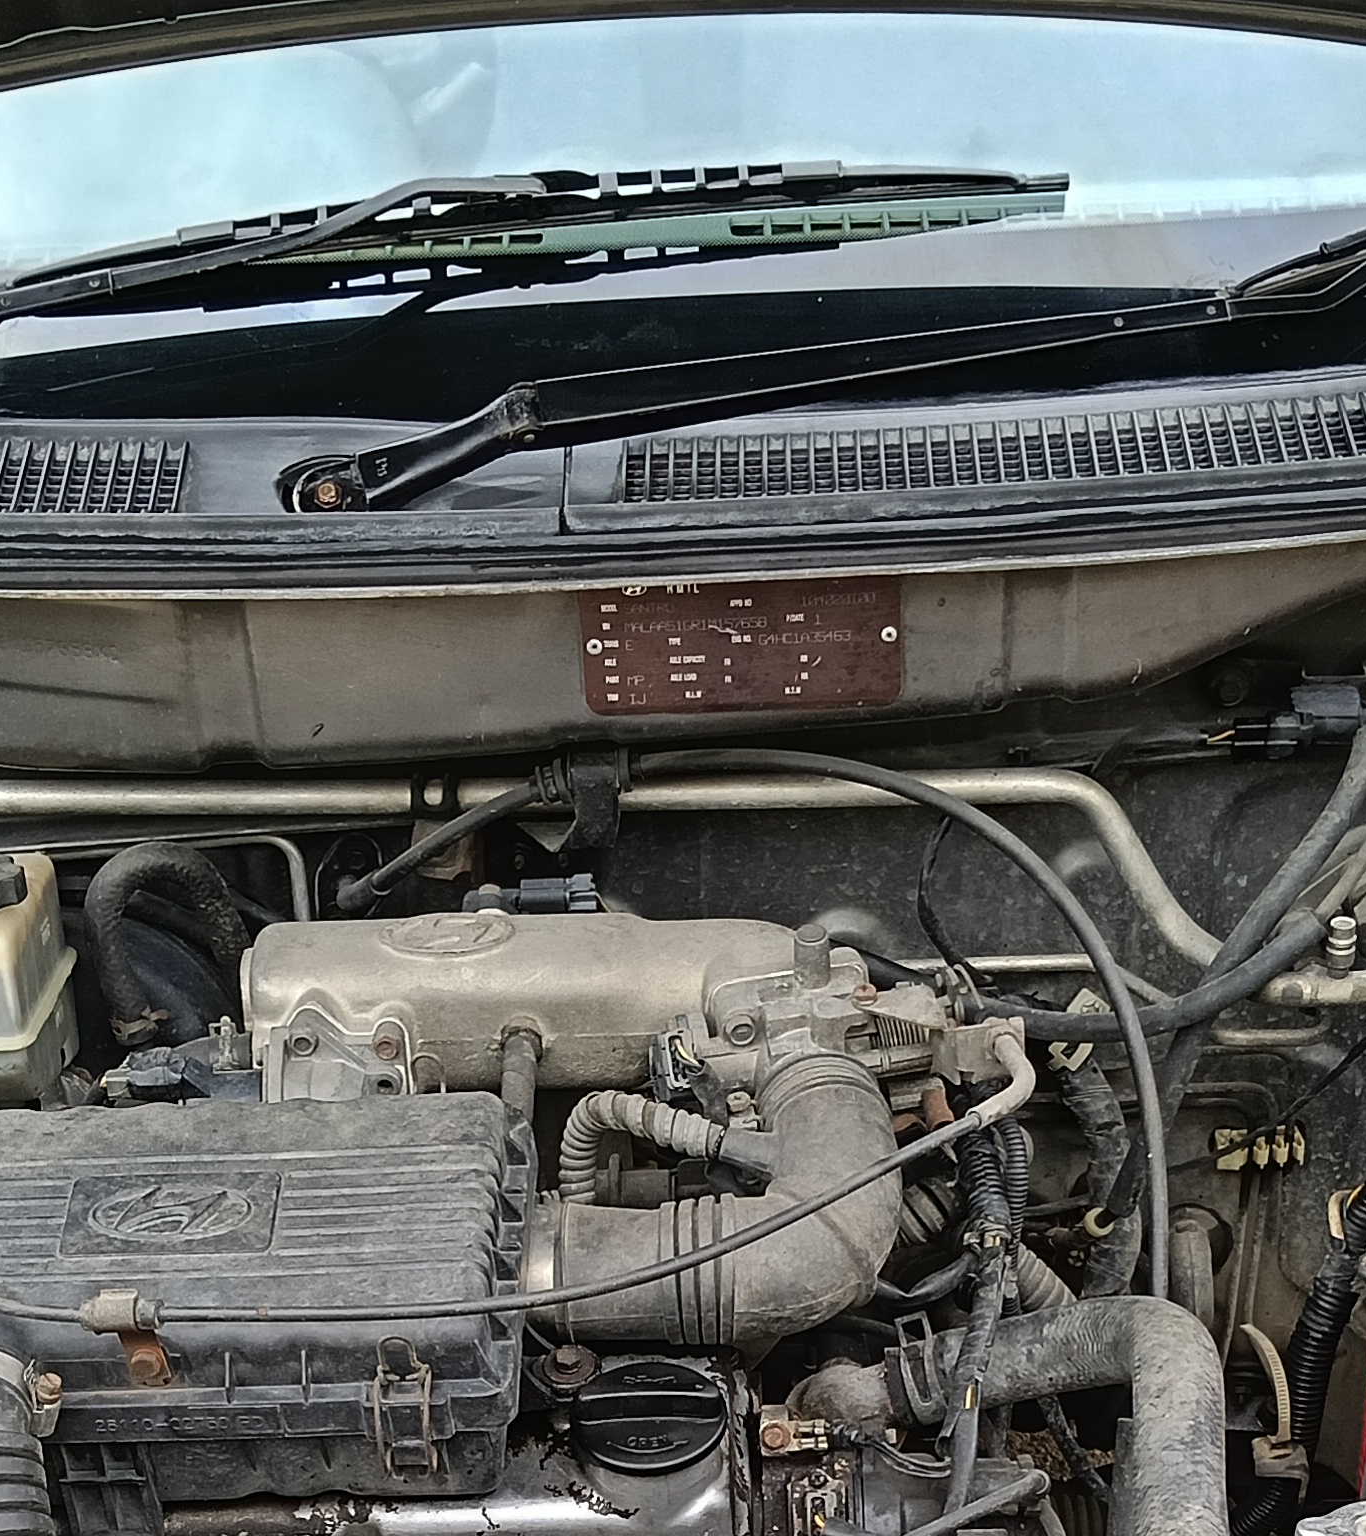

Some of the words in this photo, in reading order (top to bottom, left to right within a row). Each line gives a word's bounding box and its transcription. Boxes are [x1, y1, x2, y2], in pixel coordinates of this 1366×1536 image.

[623, 602, 675, 614] SANTRO
[625, 640, 634, 651] E
[627, 676, 645, 686] MP
